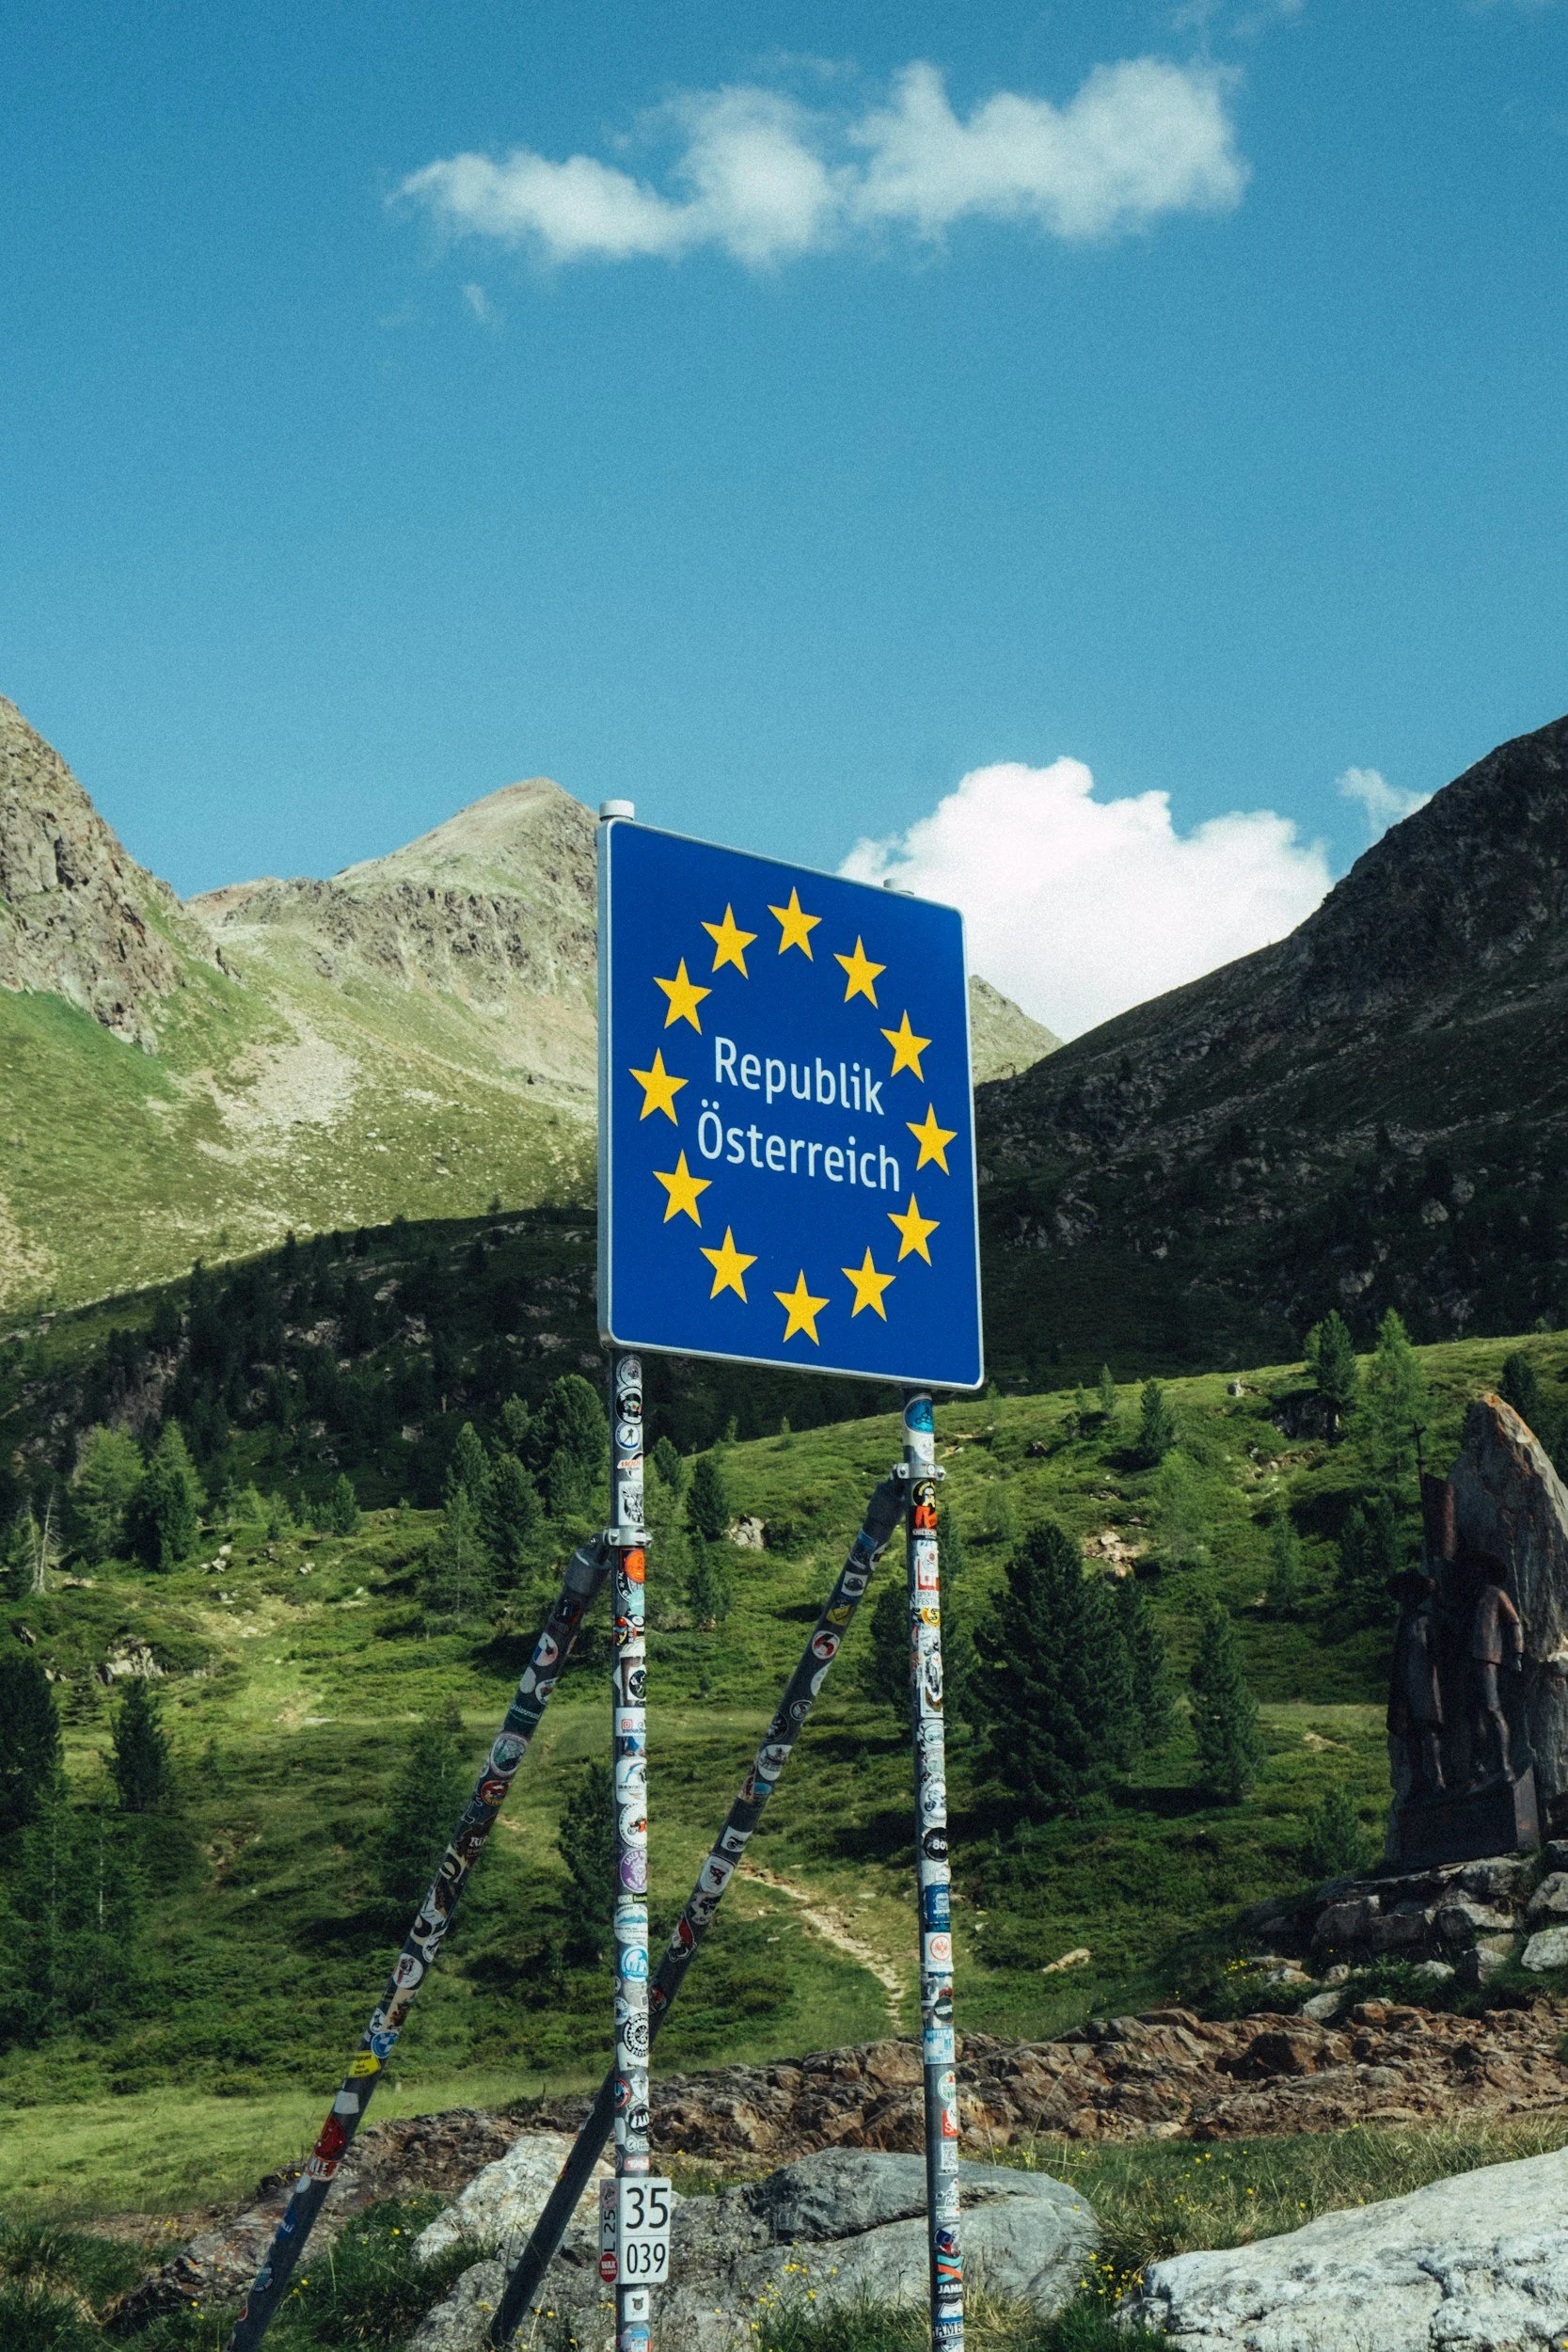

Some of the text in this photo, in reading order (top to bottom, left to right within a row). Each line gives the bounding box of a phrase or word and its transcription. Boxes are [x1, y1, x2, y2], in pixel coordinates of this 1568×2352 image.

[715, 1036, 884, 1115] Republik
[698, 1099, 900, 1192] Österreich
[626, 2186, 669, 2230] 35
[603, 2210, 616, 2252] L 25
[626, 2243, 666, 2274] 039
